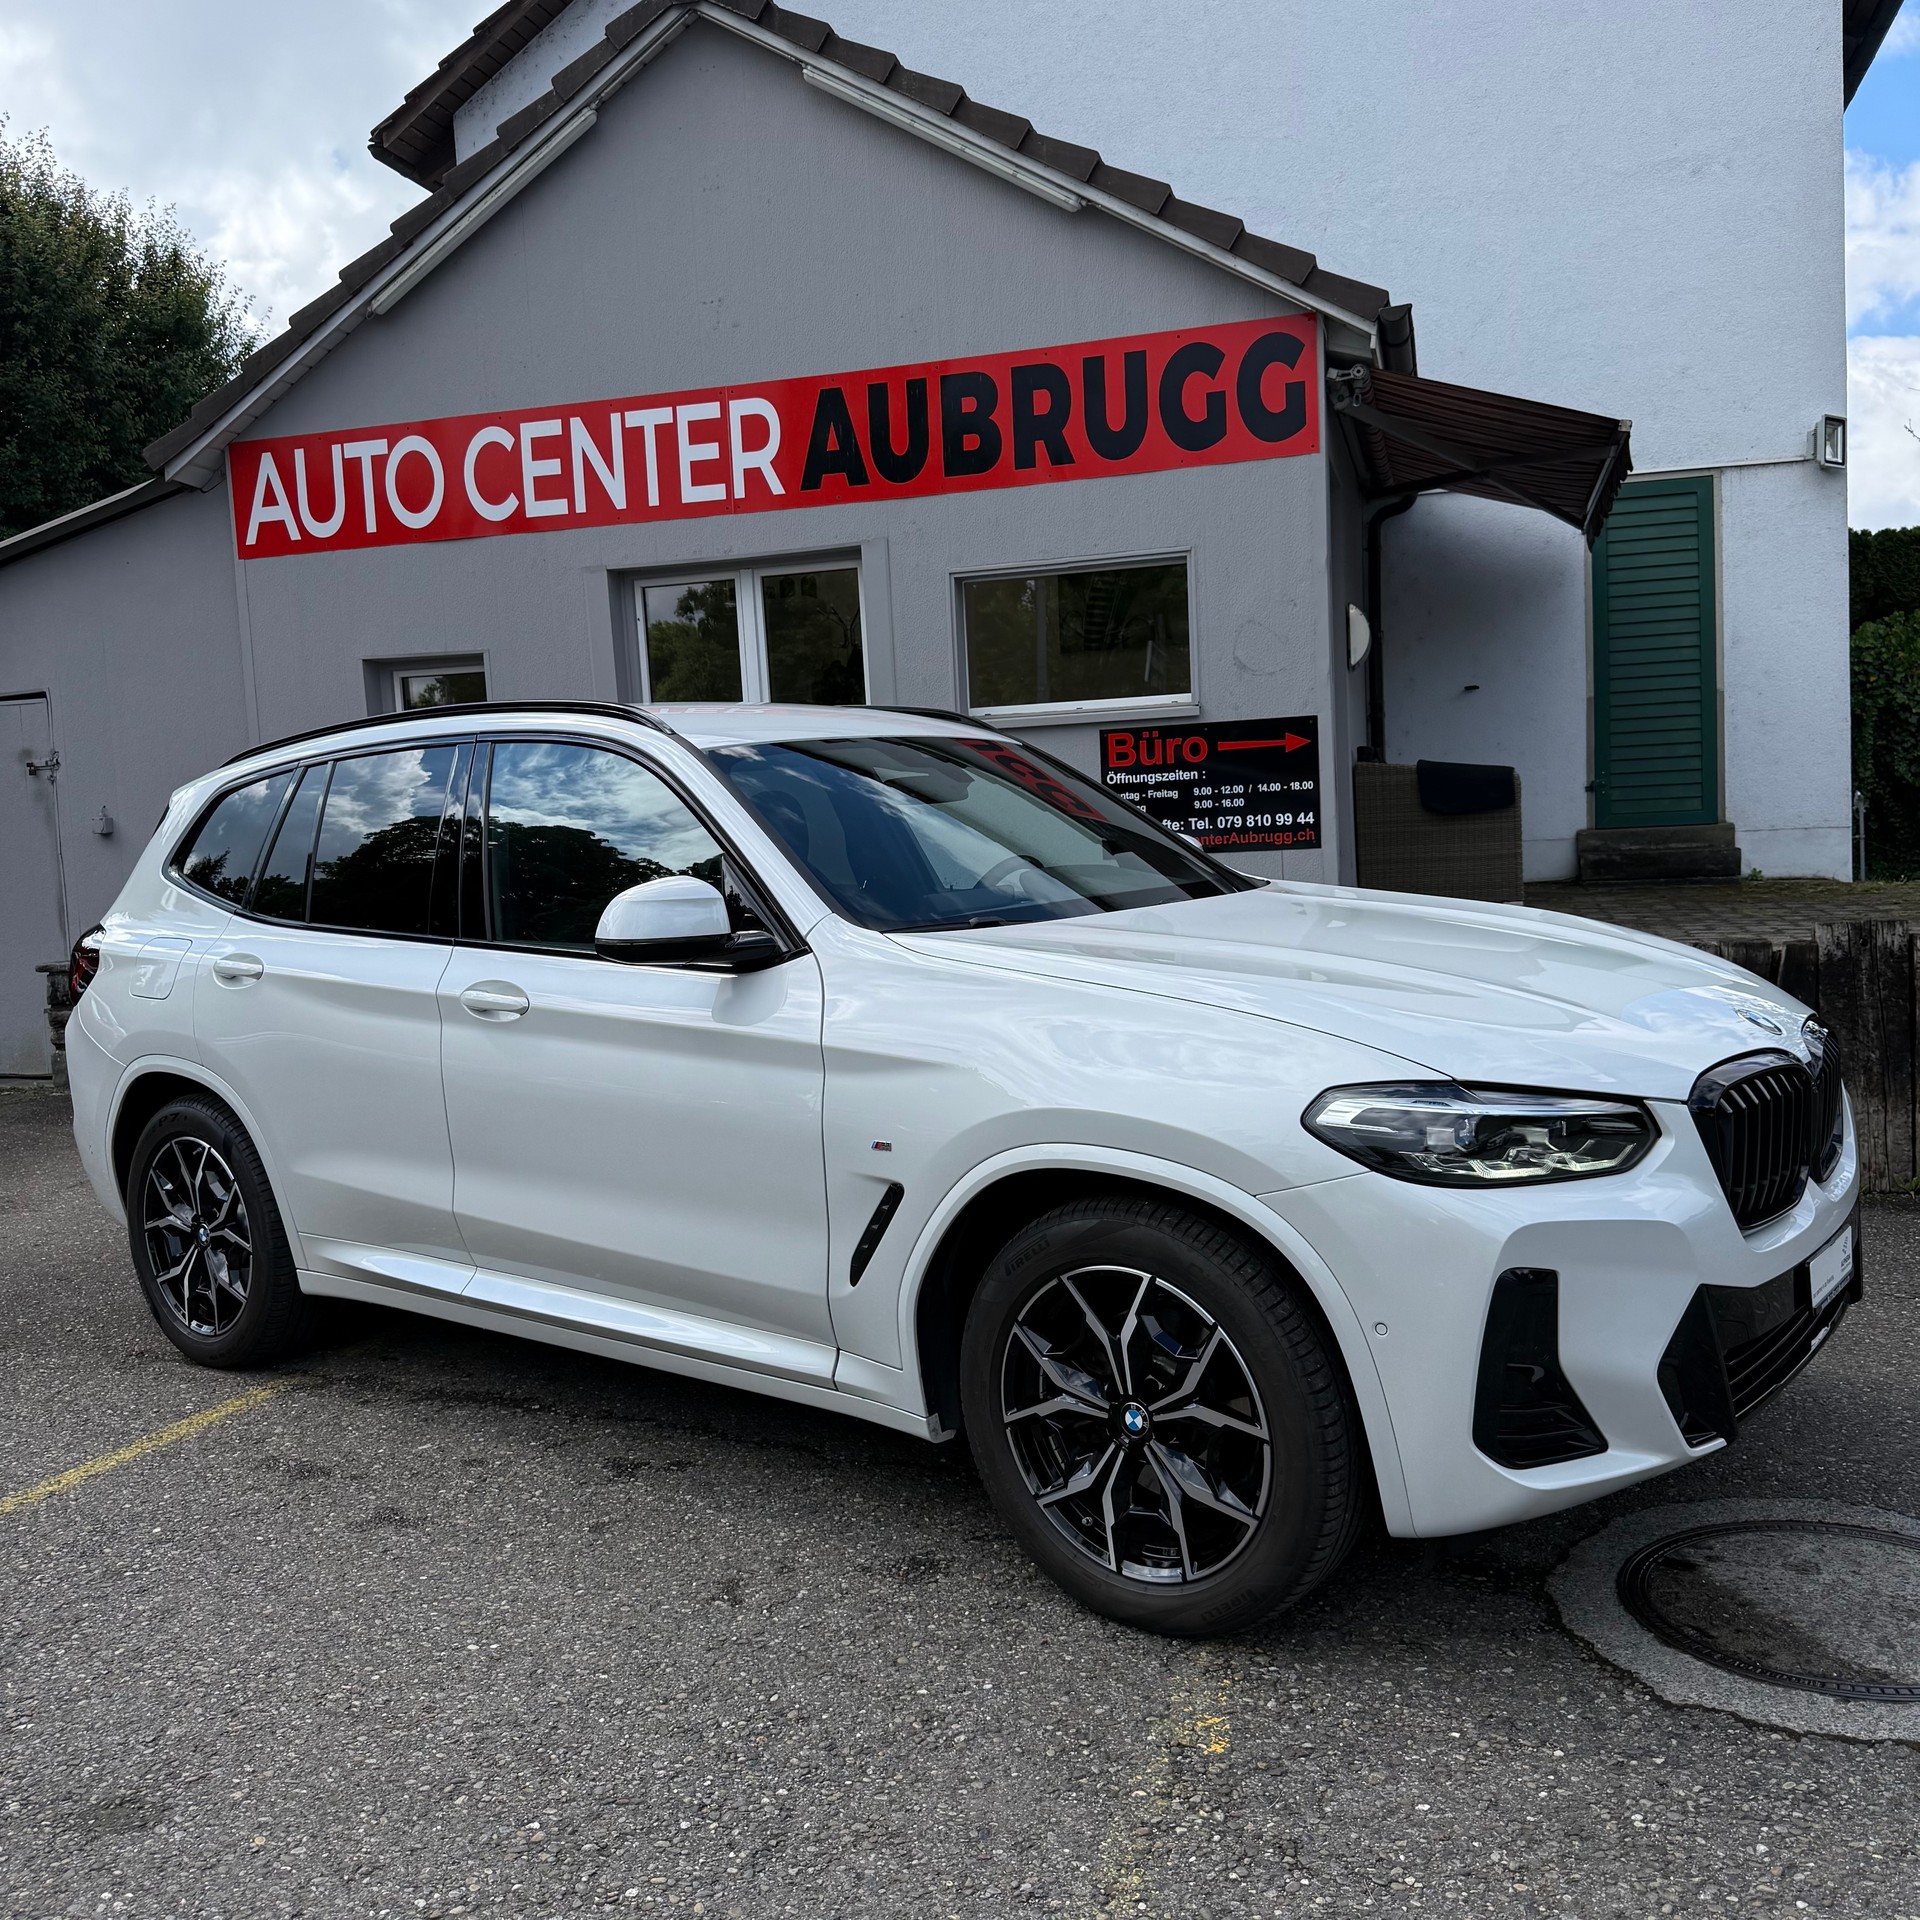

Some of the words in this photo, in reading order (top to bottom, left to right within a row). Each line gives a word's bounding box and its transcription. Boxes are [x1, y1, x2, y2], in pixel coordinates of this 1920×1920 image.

[245, 435, 445, 546] AUTO
[463, 397, 786, 522] CENTER
[800, 331, 1307, 491] AUBRUGG
[1107, 731, 1208, 768] Büro
[1106, 769, 1199, 785] Öffnungszeiten
[1119, 791, 1140, 801] ntag
[1147, 789, 1179, 799] Freitag
[1193, 787, 1212, 796] 9.00
[1220, 785, 1244, 794] 12.00
[1257, 783, 1281, 792] 14.00
[1289, 781, 1314, 790] 18.00
[1194, 799, 1213, 809] 9.00
[1221, 798, 1245, 807] 16.00
[1188, 816, 1213, 830] Tel.
[1217, 815, 1242, 828] 079
[1246, 814, 1271, 827] 810
[1275, 813, 1293, 825] 99
[1296, 811, 1315, 824] 44
